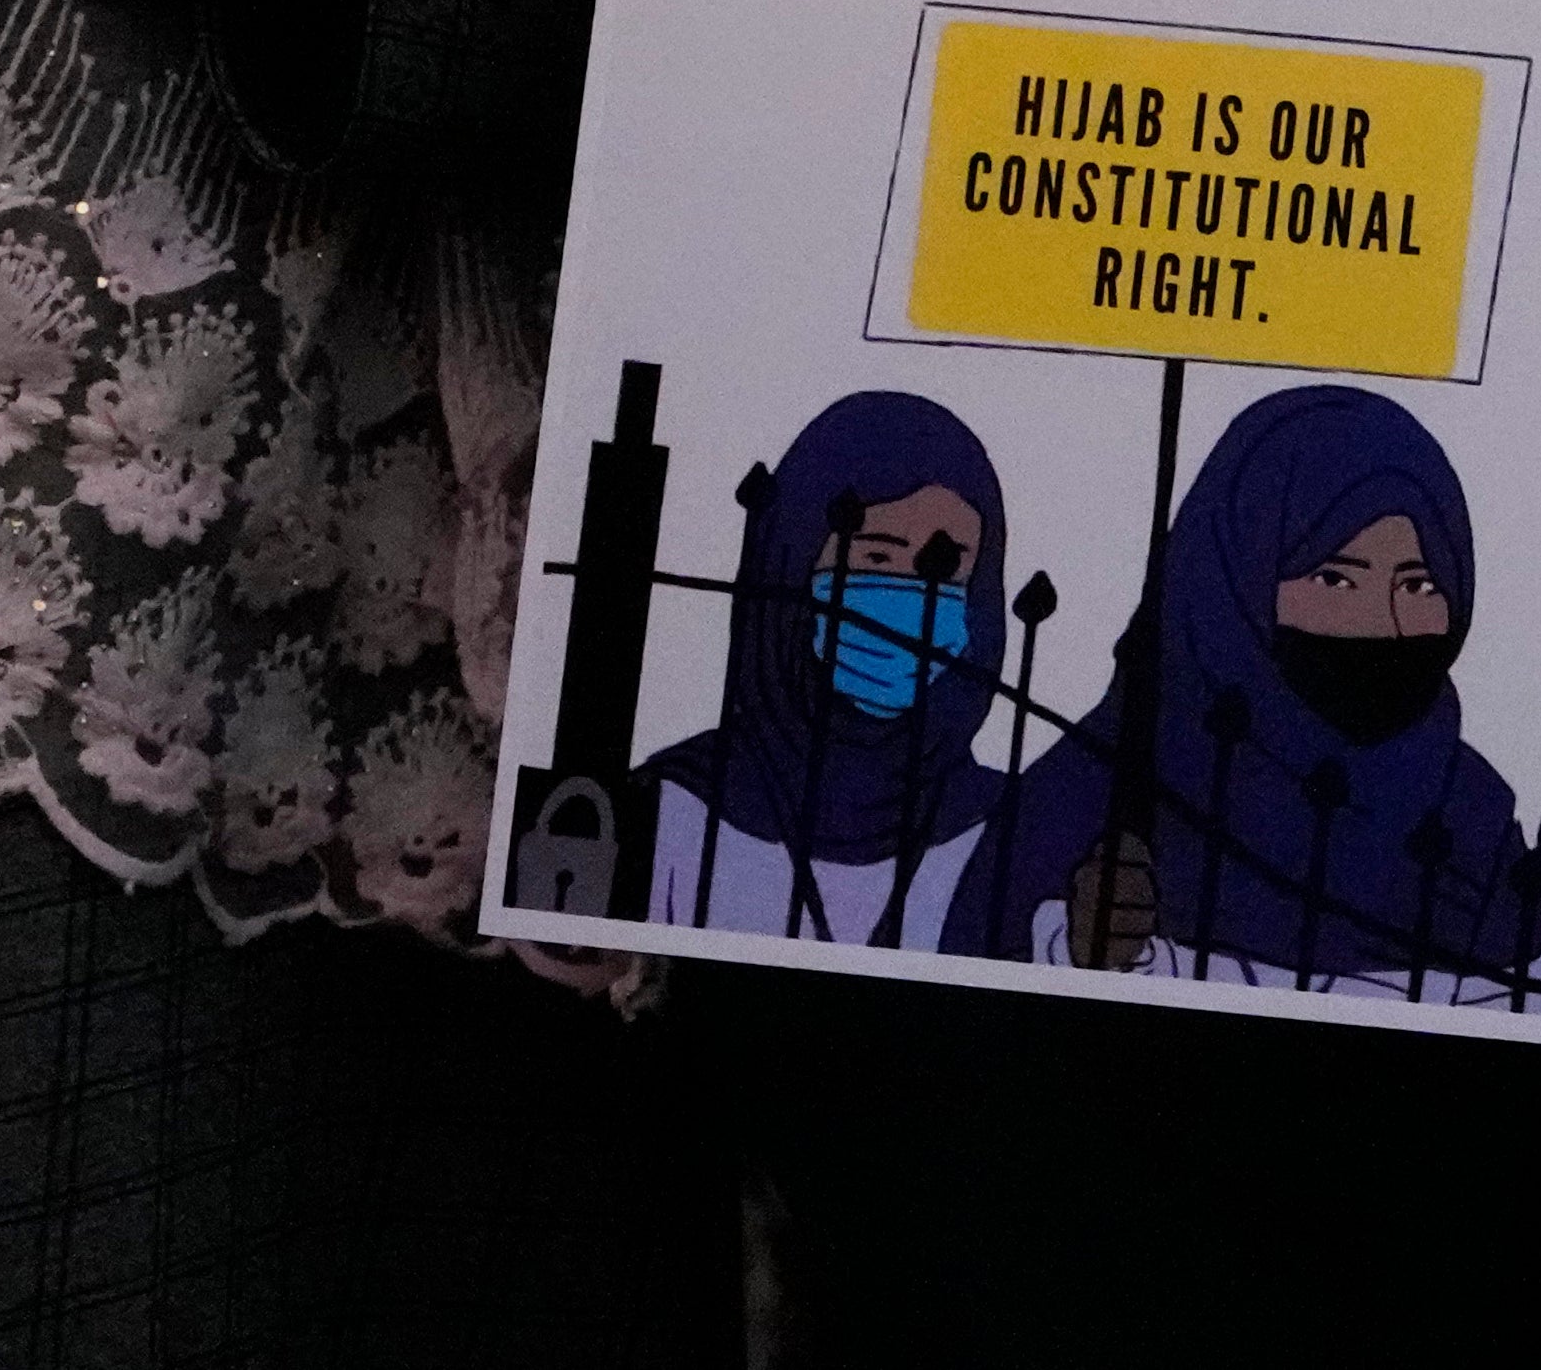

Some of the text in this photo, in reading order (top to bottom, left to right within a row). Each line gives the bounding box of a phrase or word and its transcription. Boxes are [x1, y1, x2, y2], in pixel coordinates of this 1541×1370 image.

[1014, 75, 1370, 169] HIJAB IS OUR
[964, 152, 1422, 256] CONSTITUTIONAL
[1093, 247, 1269, 323] RIGHT.
